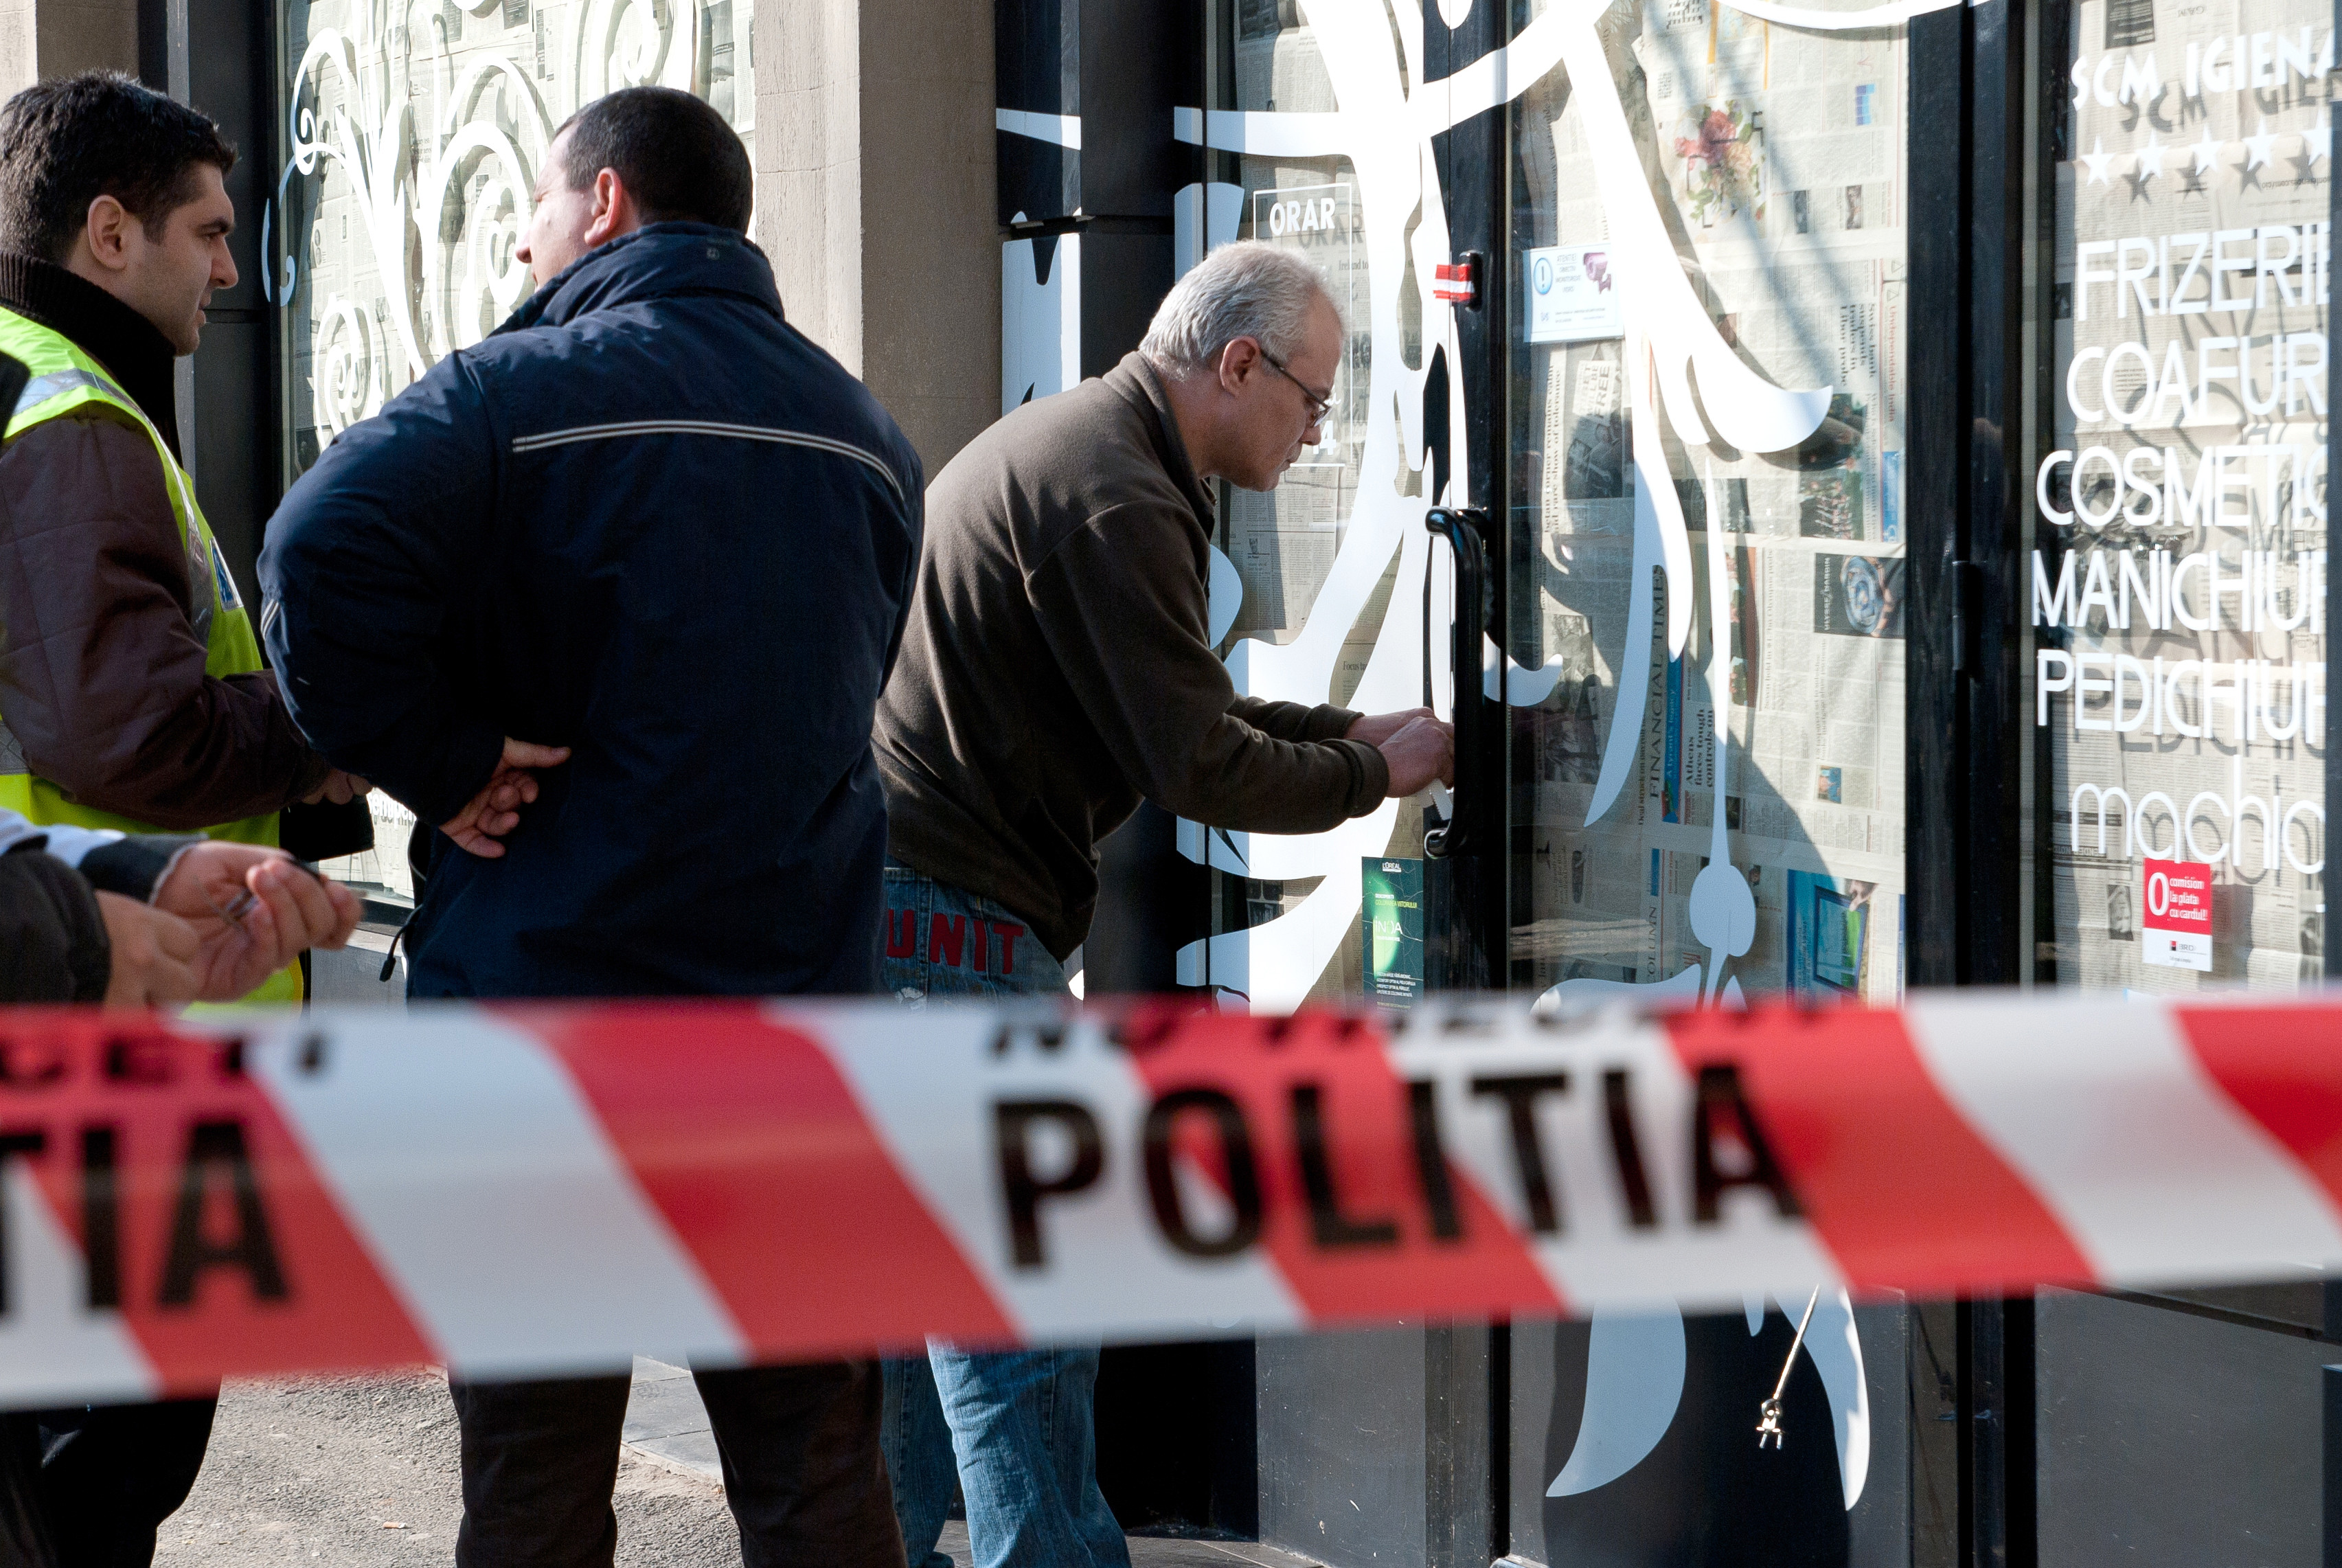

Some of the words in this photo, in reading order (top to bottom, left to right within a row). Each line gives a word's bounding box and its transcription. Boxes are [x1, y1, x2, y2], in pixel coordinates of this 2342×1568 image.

[2071, 51, 2161, 111] SCM
[1269, 197, 1336, 236] ORAR
[1839, 306, 1848, 343] Libor
[1838, 347, 1848, 387] probe
[1887, 305, 1897, 391] Undependable
[1594, 365, 1609, 420] FREE
[1887, 394, 1896, 422] India
[1545, 398, 1553, 448] remains
[1552, 432, 1560, 443] of
[1649, 653, 1663, 797] FINANCIAL
[1696, 708, 1706, 747] tough
[1707, 709, 1714, 727] on
[1685, 736, 1694, 784] Athens
[1694, 751, 1703, 785] faces
[1705, 729, 1714, 787] controls
[2148, 872, 2170, 916] 0
[2169, 876, 2205, 889] comision
[2170, 890, 2179, 902] la
[2169, 908, 2179, 918] cu
[886, 909, 1024, 975] UNIT
[994, 1061, 1808, 1272] POLITIA
